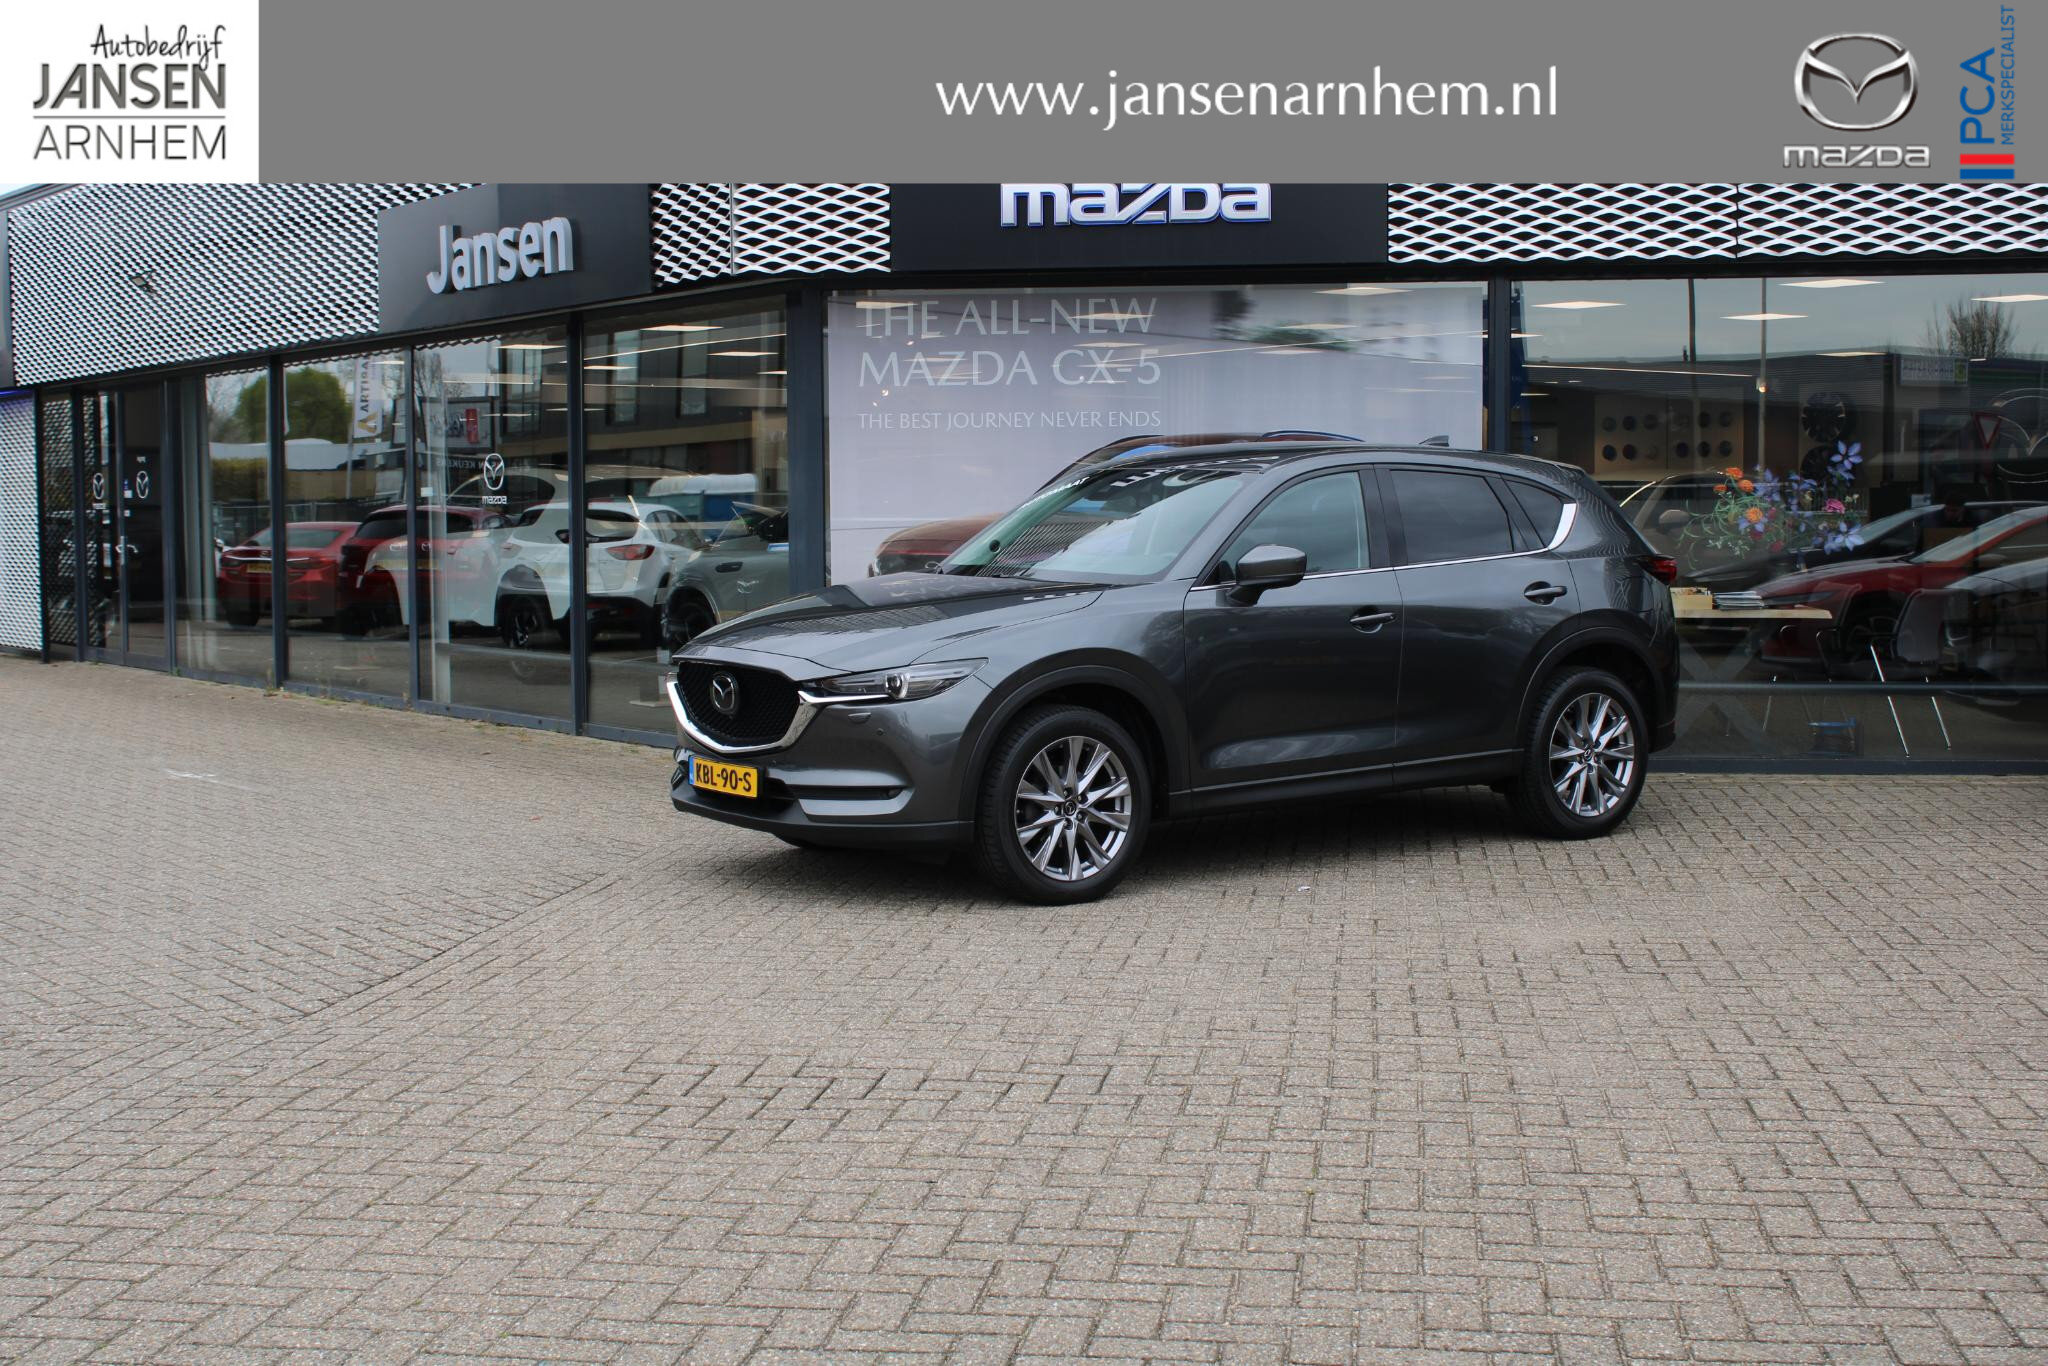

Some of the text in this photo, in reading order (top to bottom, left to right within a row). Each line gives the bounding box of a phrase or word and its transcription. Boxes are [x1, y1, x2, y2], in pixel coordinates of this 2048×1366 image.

[426, 217, 574, 294] Jansen
[858, 297, 1157, 337] THE ALL-NEW
[859, 348, 1161, 387] MAZDA CX-5
[857, 410, 1161, 431] THE BEST JOURNEY NEVER ENDS
[695, 762, 752, 793] KBL-90-S
